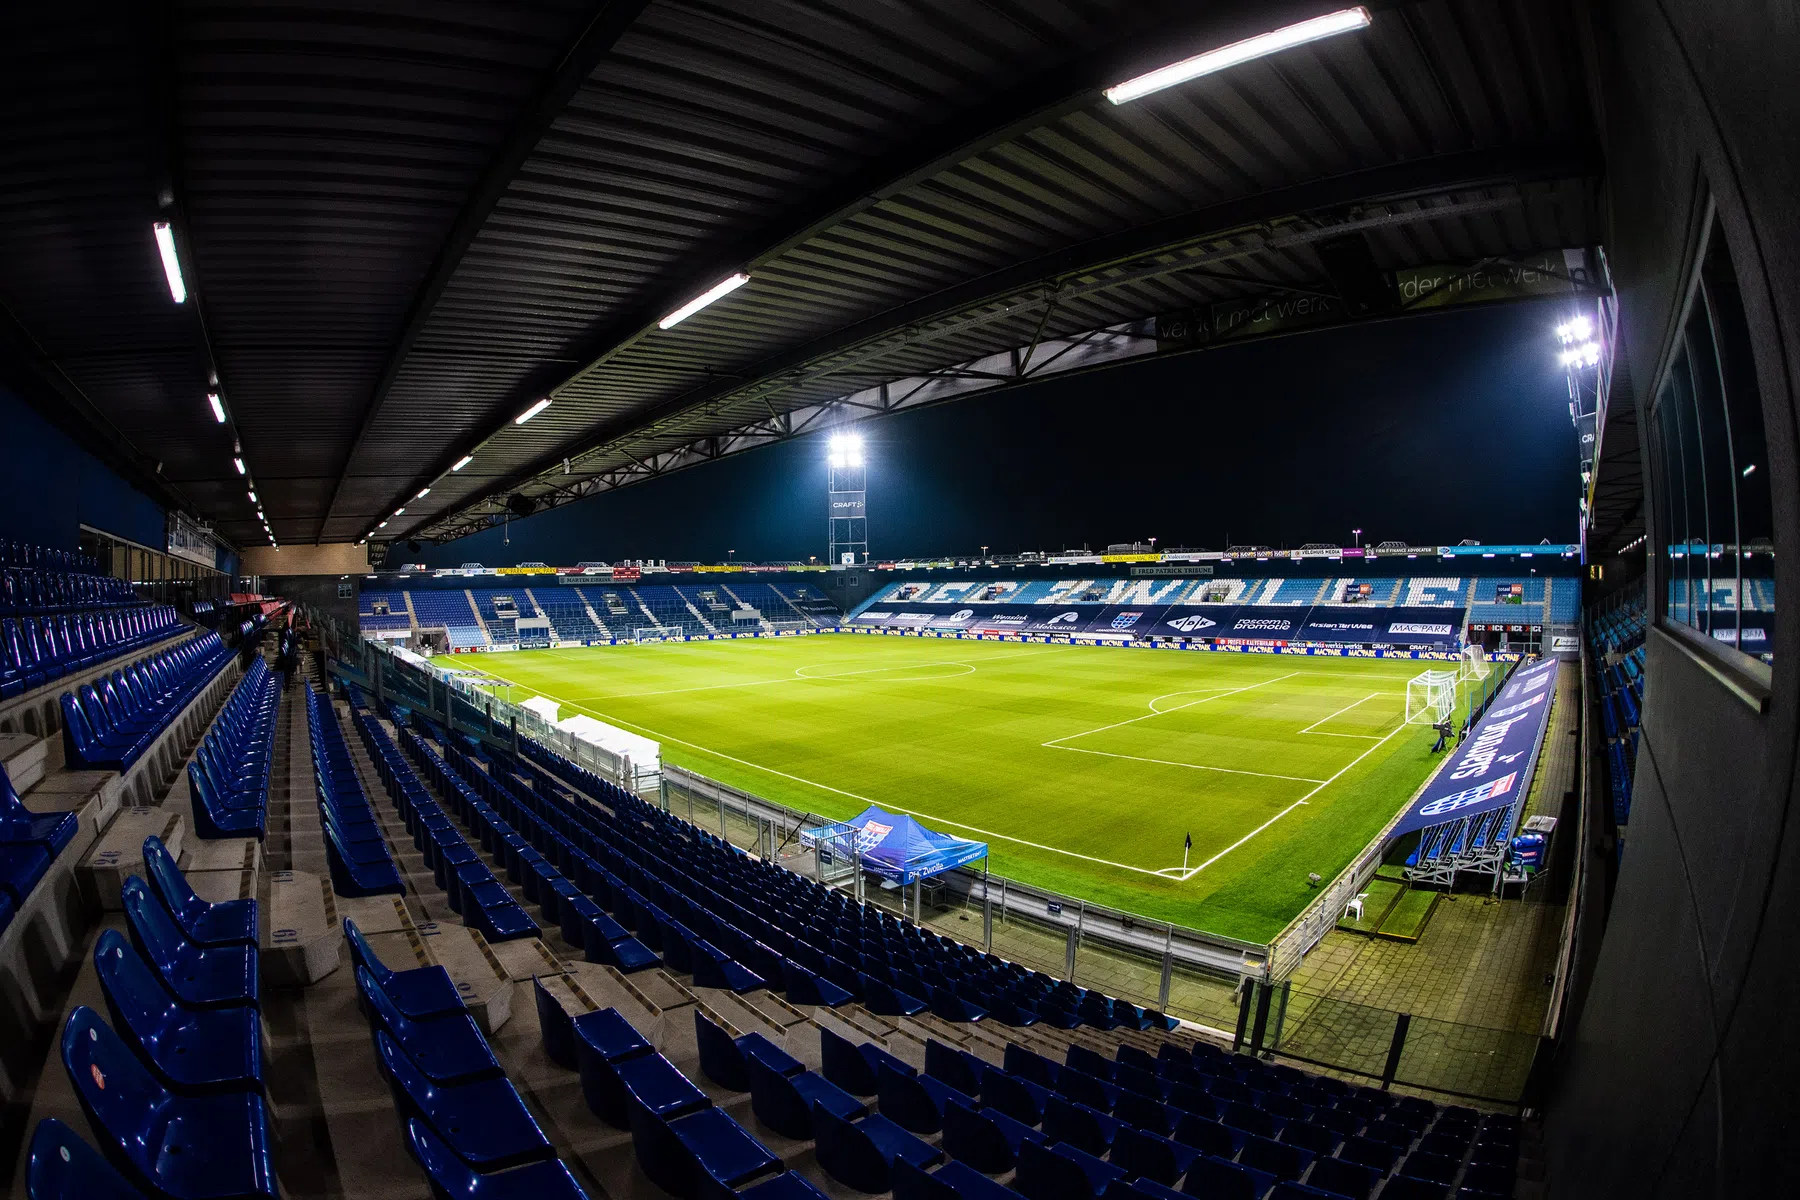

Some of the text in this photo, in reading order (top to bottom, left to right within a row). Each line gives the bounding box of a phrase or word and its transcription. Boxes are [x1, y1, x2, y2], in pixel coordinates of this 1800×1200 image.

[1449, 711, 1529, 779] brouwers
[923, 863, 944, 876] Zwolle
[272, 929, 297, 943] 19
